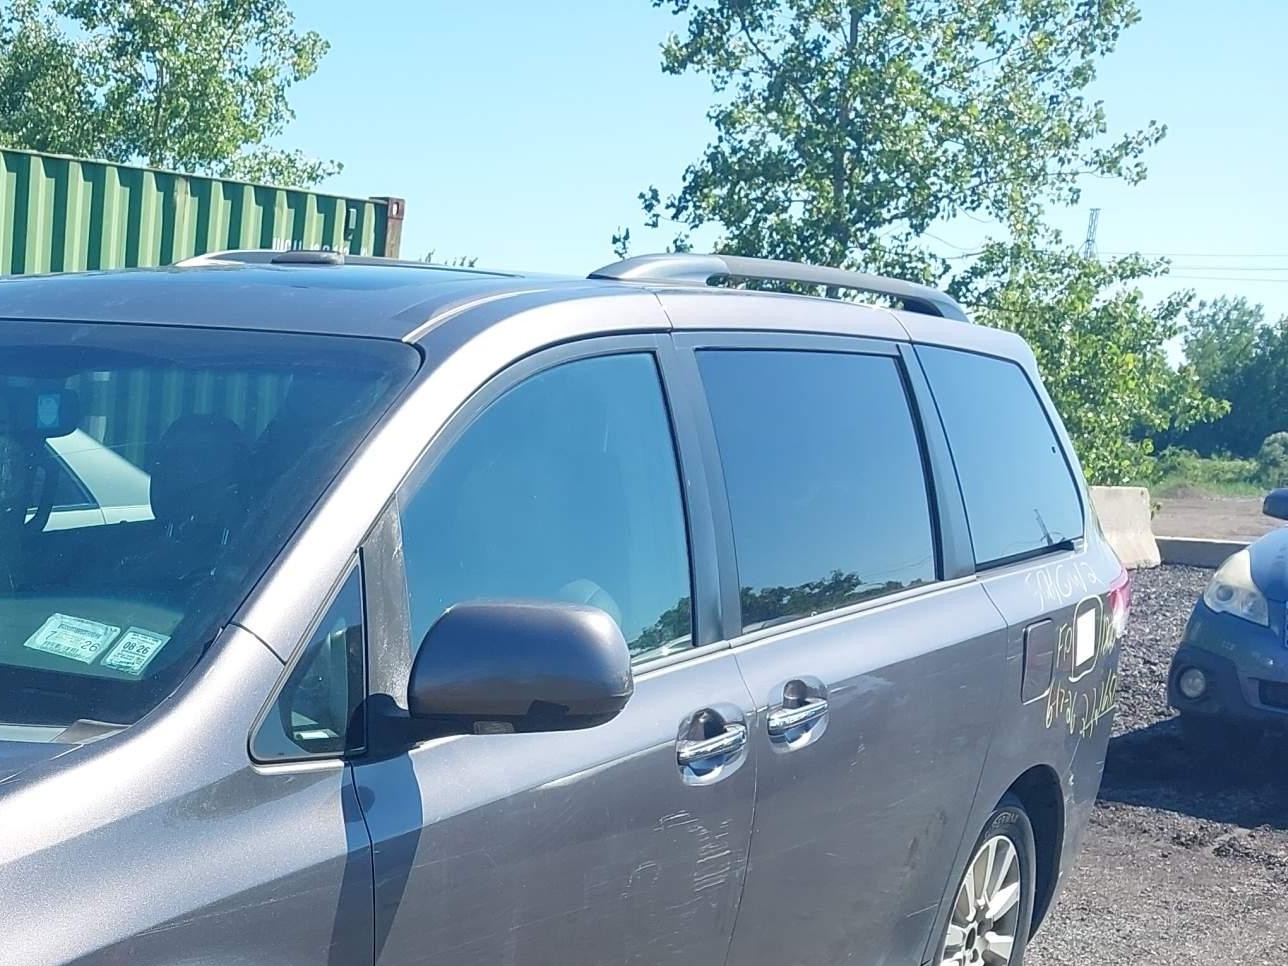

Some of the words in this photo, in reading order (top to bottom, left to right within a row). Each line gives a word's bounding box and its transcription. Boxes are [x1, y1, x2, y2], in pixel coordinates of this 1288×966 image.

[80, 640, 100, 652] 26
[122, 641, 136, 651] 08
[136, 644, 151, 655] 26
